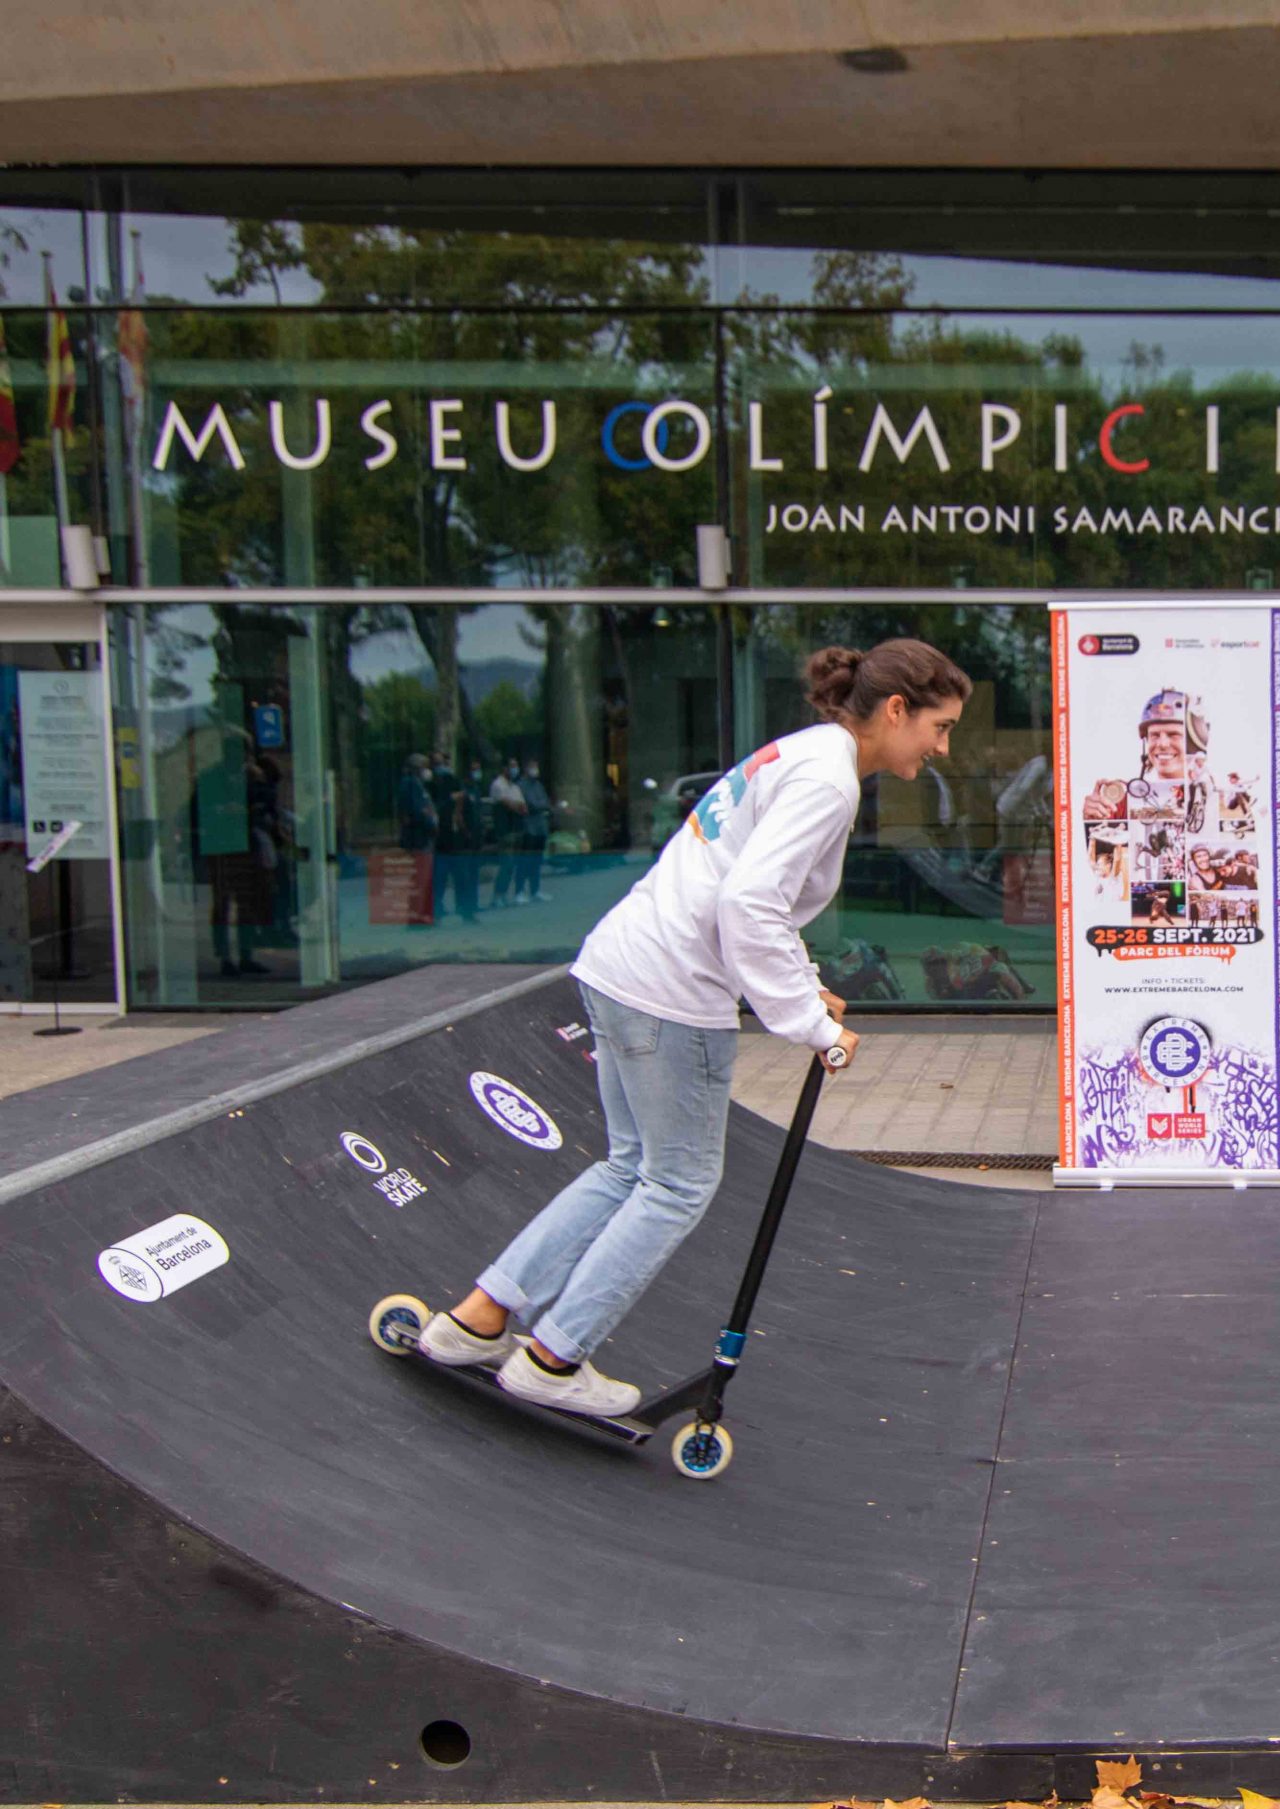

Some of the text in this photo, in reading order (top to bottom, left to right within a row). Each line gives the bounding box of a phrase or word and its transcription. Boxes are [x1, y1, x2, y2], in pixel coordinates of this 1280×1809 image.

[154, 400, 556, 471] MUSEU
[1205, 405, 1219, 474] I
[766, 504, 865, 534] JOAN
[881, 505, 1036, 534] ANTONI
[1062, 909, 1070, 959] BARCELONA
[1094, 928, 1255, 944] 25-26 SEPT. 2021
[1120, 947, 1154, 957] PARC
[1158, 947, 1182, 956] DEL
[1146, 1018, 1205, 1041] EXTREME
[1064, 1058, 1072, 1096] EXTREME
[1143, 1055, 1208, 1086] BARCELONA
[373, 1168, 412, 1193] WORLD
[387, 1178, 428, 1207] SKATE
[145, 1226, 198, 1256] Ajuntament de
[156, 1239, 212, 1271] Barcelona
